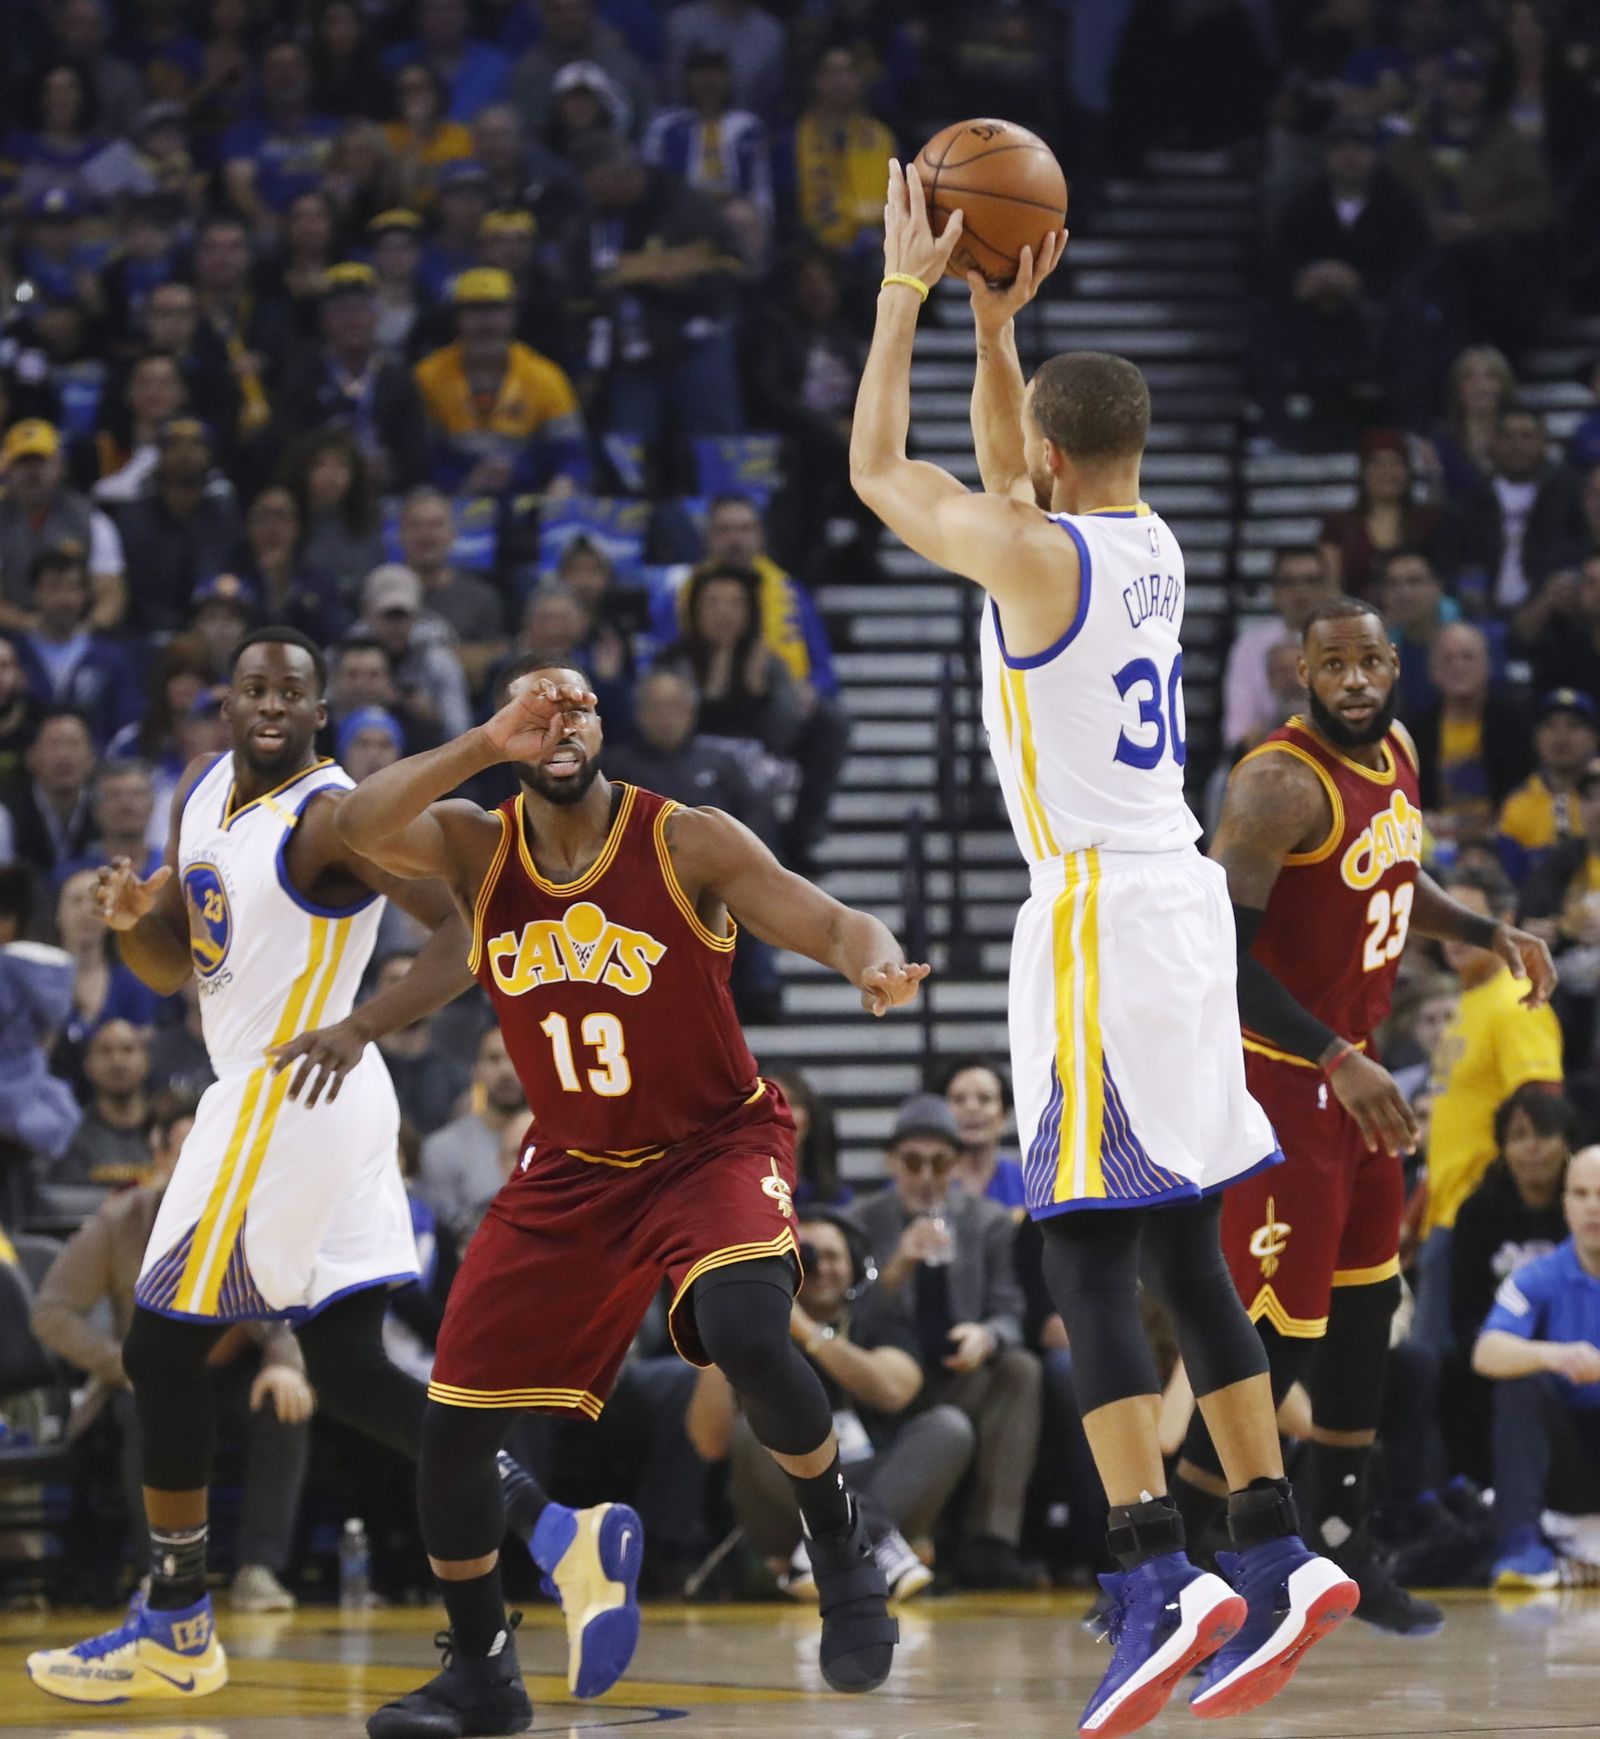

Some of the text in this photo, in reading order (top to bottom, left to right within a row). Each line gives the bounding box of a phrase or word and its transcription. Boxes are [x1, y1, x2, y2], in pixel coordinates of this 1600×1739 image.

[1122, 573, 1181, 629] CURRY
[202, 887, 224, 924] 23
[487, 901, 668, 996] CAVS
[1362, 880, 1414, 973] 23
[539, 1011, 632, 1097] 13
